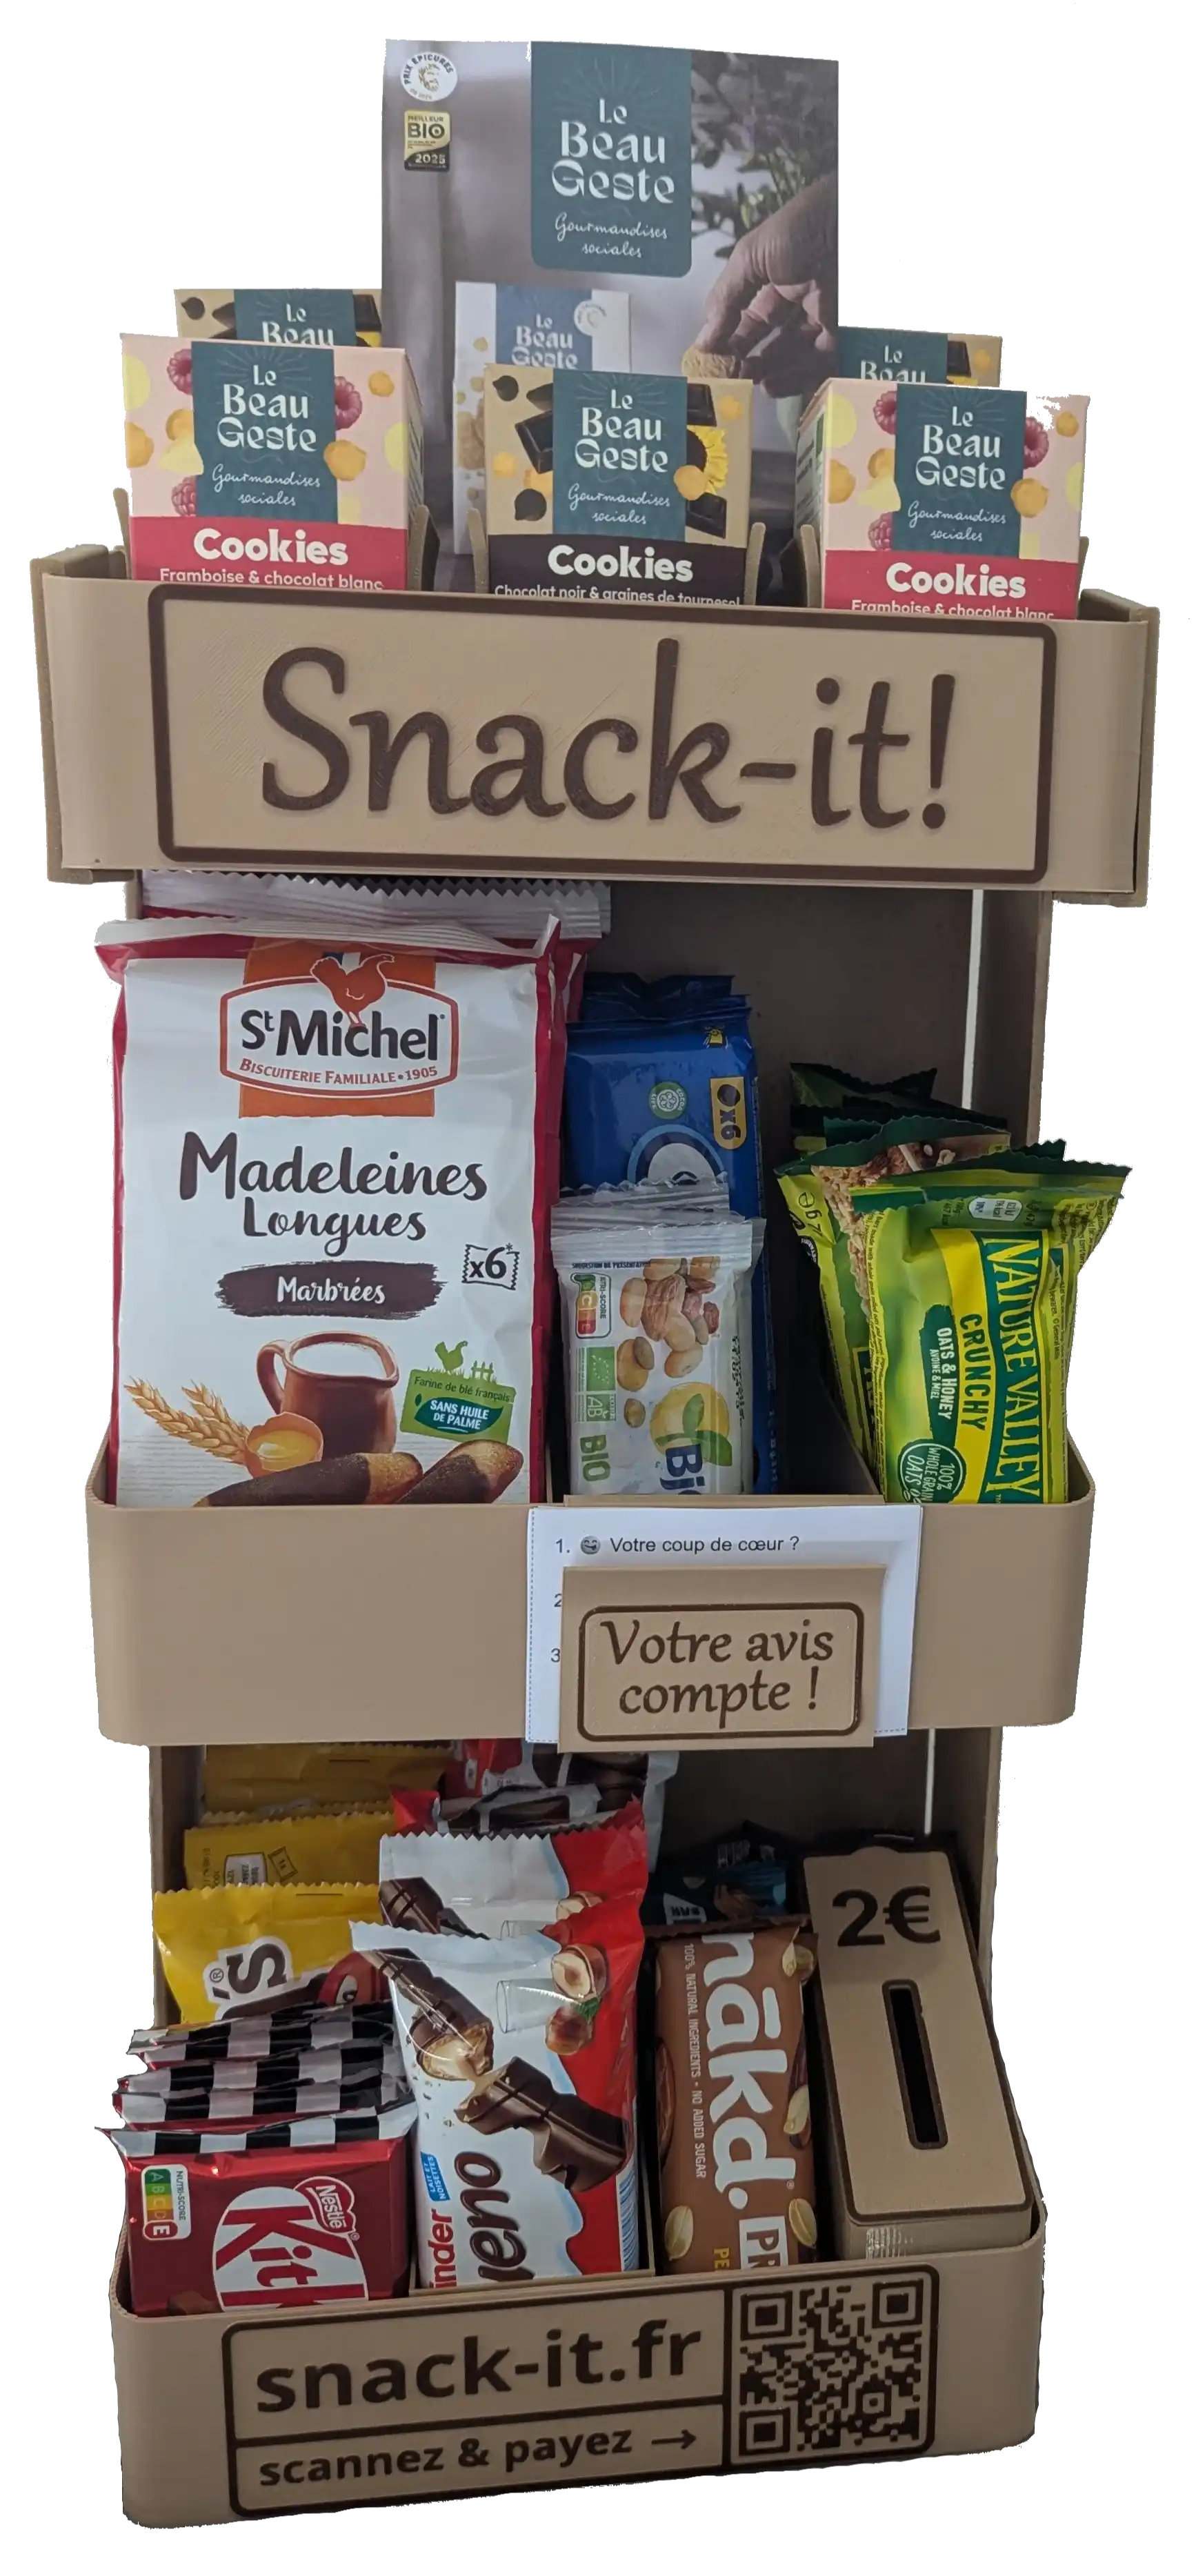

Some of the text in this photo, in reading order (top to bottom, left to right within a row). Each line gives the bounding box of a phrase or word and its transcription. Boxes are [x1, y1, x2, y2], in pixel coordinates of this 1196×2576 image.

[403, 65, 412, 84] PRIX
[599, 98, 628, 124] Le
[408, 123, 445, 139] BIO
[561, 120, 666, 164] Beau
[415, 154, 446, 164] 2025
[551, 159, 675, 204] Geste
[554, 212, 668, 242] Gourmandises
[581, 241, 642, 258] sociales
[286, 304, 306, 322] Le
[536, 314, 552, 329] Le
[262, 321, 335, 346] Beau
[516, 326, 573, 348] Beau
[511, 346, 577, 368] Geste
[884, 345, 903, 364] Le
[253, 364, 276, 386] Le
[860, 360, 926, 383] Beau
[223, 384, 308, 419] Beau
[611, 389, 633, 410] Le
[582, 407, 661, 441] Beau
[953, 406, 974, 428] Le
[217, 417, 317, 452] Geste
[924, 424, 1001, 459] Beau
[575, 439, 669, 473] Geste
[212, 464, 321, 493] Gourmandises
[915, 456, 1006, 491] Geste
[239, 491, 296, 506] sociales
[568, 484, 670, 511] Gourmandises
[592, 510, 647, 525] sociales
[908, 501, 1006, 528] Gourmandises
[193, 528, 349, 566] Cookies
[930, 528, 983, 542] sociales
[548, 544, 693, 582] Cookies
[160, 568, 245, 584] Framboise
[249, 569, 260, 584] &
[264, 571, 335, 588] chocolat
[886, 563, 1026, 599] Cookies
[495, 585, 556, 597] Chocolat
[559, 586, 588, 598] noir
[590, 587, 599, 599] &
[657, 588, 675, 603] de
[852, 600, 930, 614] Framboise
[935, 602, 944, 614] &
[949, 603, 1012, 617] chocolat
[261, 637, 956, 831] Snack-it!
[239, 1058, 438, 1084] BISCUITERIE FAMILIALE 1905
[179, 1131, 488, 1201] Madeleines
[243, 1196, 427, 1257] Longues
[277, 1276, 386, 1303] Marbrées
[930, 1349, 941, 1374] AVOINE
[937, 1327, 957, 1420] OATS & HONEY
[959, 1314, 991, 1431] CRUNCHY
[982, 1238, 1041, 1496] NATURE VALLEY
[415, 1376, 510, 1403] Farine de blé français
[930, 1382, 941, 1400] MIEL
[430, 1399, 489, 1420] SANS HUILE
[433, 1412, 481, 1429] DE PALME
[579, 1435, 611, 1482] BIO
[905, 1455, 925, 1485] OATS
[921, 1447, 941, 1501] WHOLE GRAIN
[937, 1463, 955, 1490] 100%
[555, 1536, 800, 1556] 1. Votre coup de cœur ?
[554, 1593, 562, 1607] 2
[550, 1647, 560, 1662] 3
[600, 1619, 834, 1665] Votre avis
[619, 1665, 819, 1730] compte !
[832, 1885, 941, 1947] 2€
[684, 1943, 707, 2179] 100% NATURAL INGREDIENTS NO ADDED SUGAR
[428, 2155, 446, 2199] NOISETTES
[176, 2170, 186, 2221] NUTRI-SCORE
[453, 2151, 535, 2282] eno
[152, 2225, 170, 2236] E
[215, 2206, 367, 2308] Kit
[429, 2208, 457, 2288] inder
[713, 2246, 730, 2270] PE
[746, 2228, 780, 2268] PR
[255, 2319, 701, 2413] snack-it.fr
[259, 2428, 633, 2488] scannez & payez
